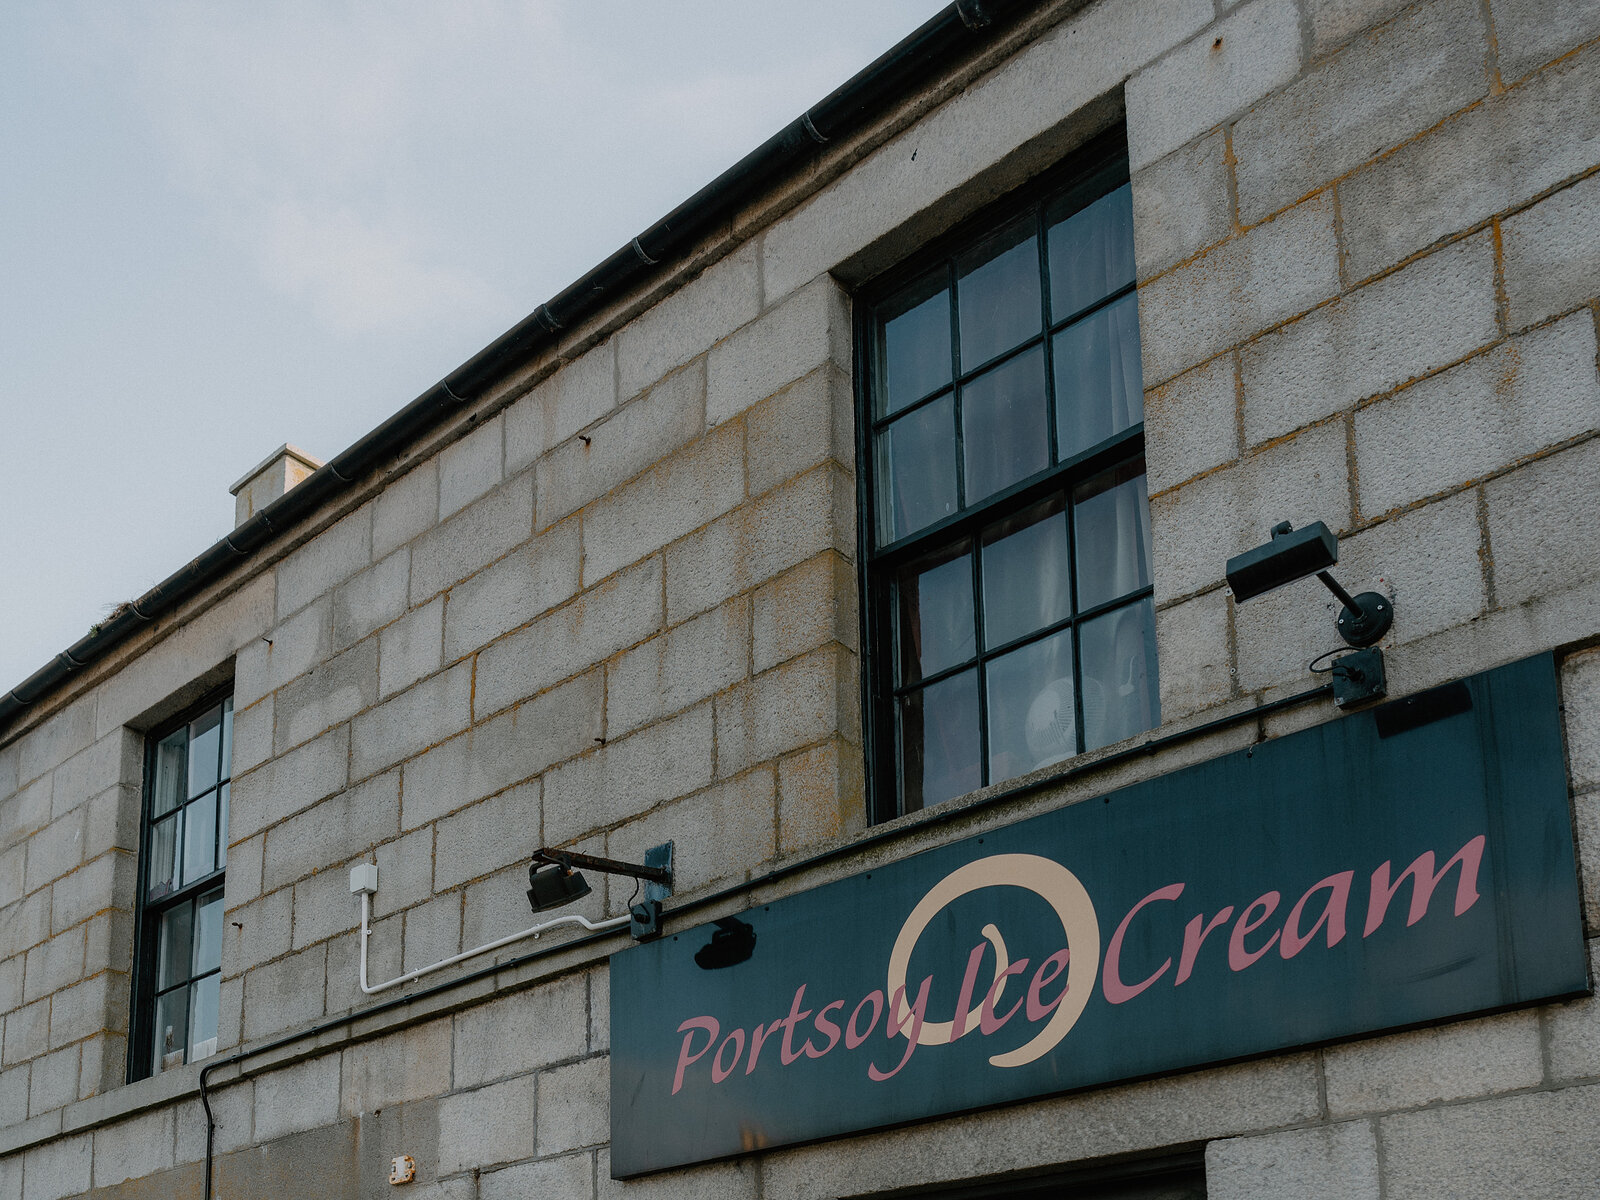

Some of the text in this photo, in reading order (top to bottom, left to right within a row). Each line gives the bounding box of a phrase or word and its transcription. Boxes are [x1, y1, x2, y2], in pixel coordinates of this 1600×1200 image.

[672, 834, 1486, 1098] Portsoy Ice Cream
